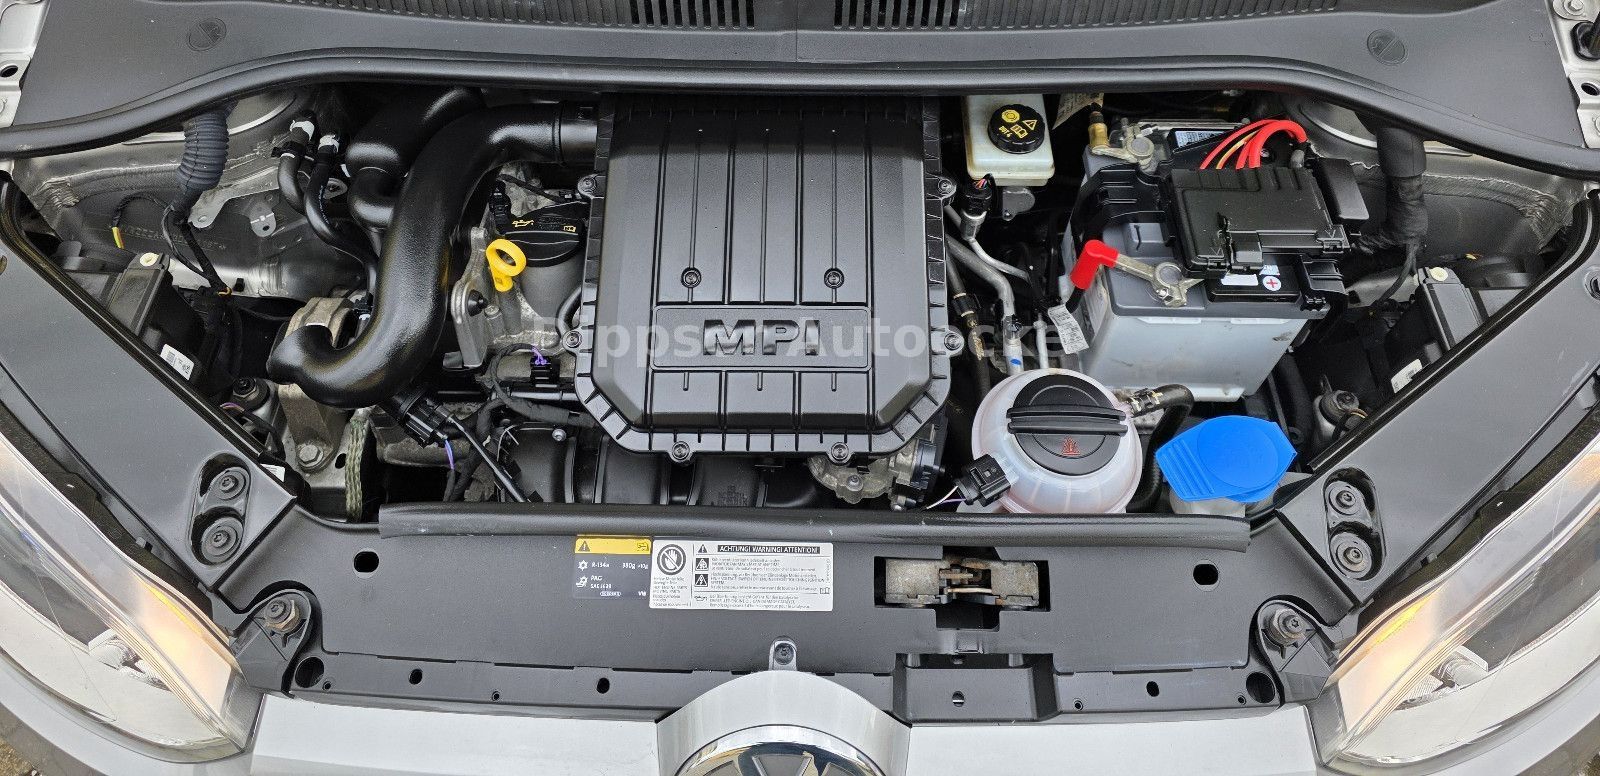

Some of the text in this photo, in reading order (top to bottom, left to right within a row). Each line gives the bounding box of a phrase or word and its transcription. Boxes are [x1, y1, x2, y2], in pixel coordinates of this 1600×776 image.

[702, 319, 821, 356] MPI
[719, 545, 818, 554] ACHTUNG! WARNING! ATTENTION!
